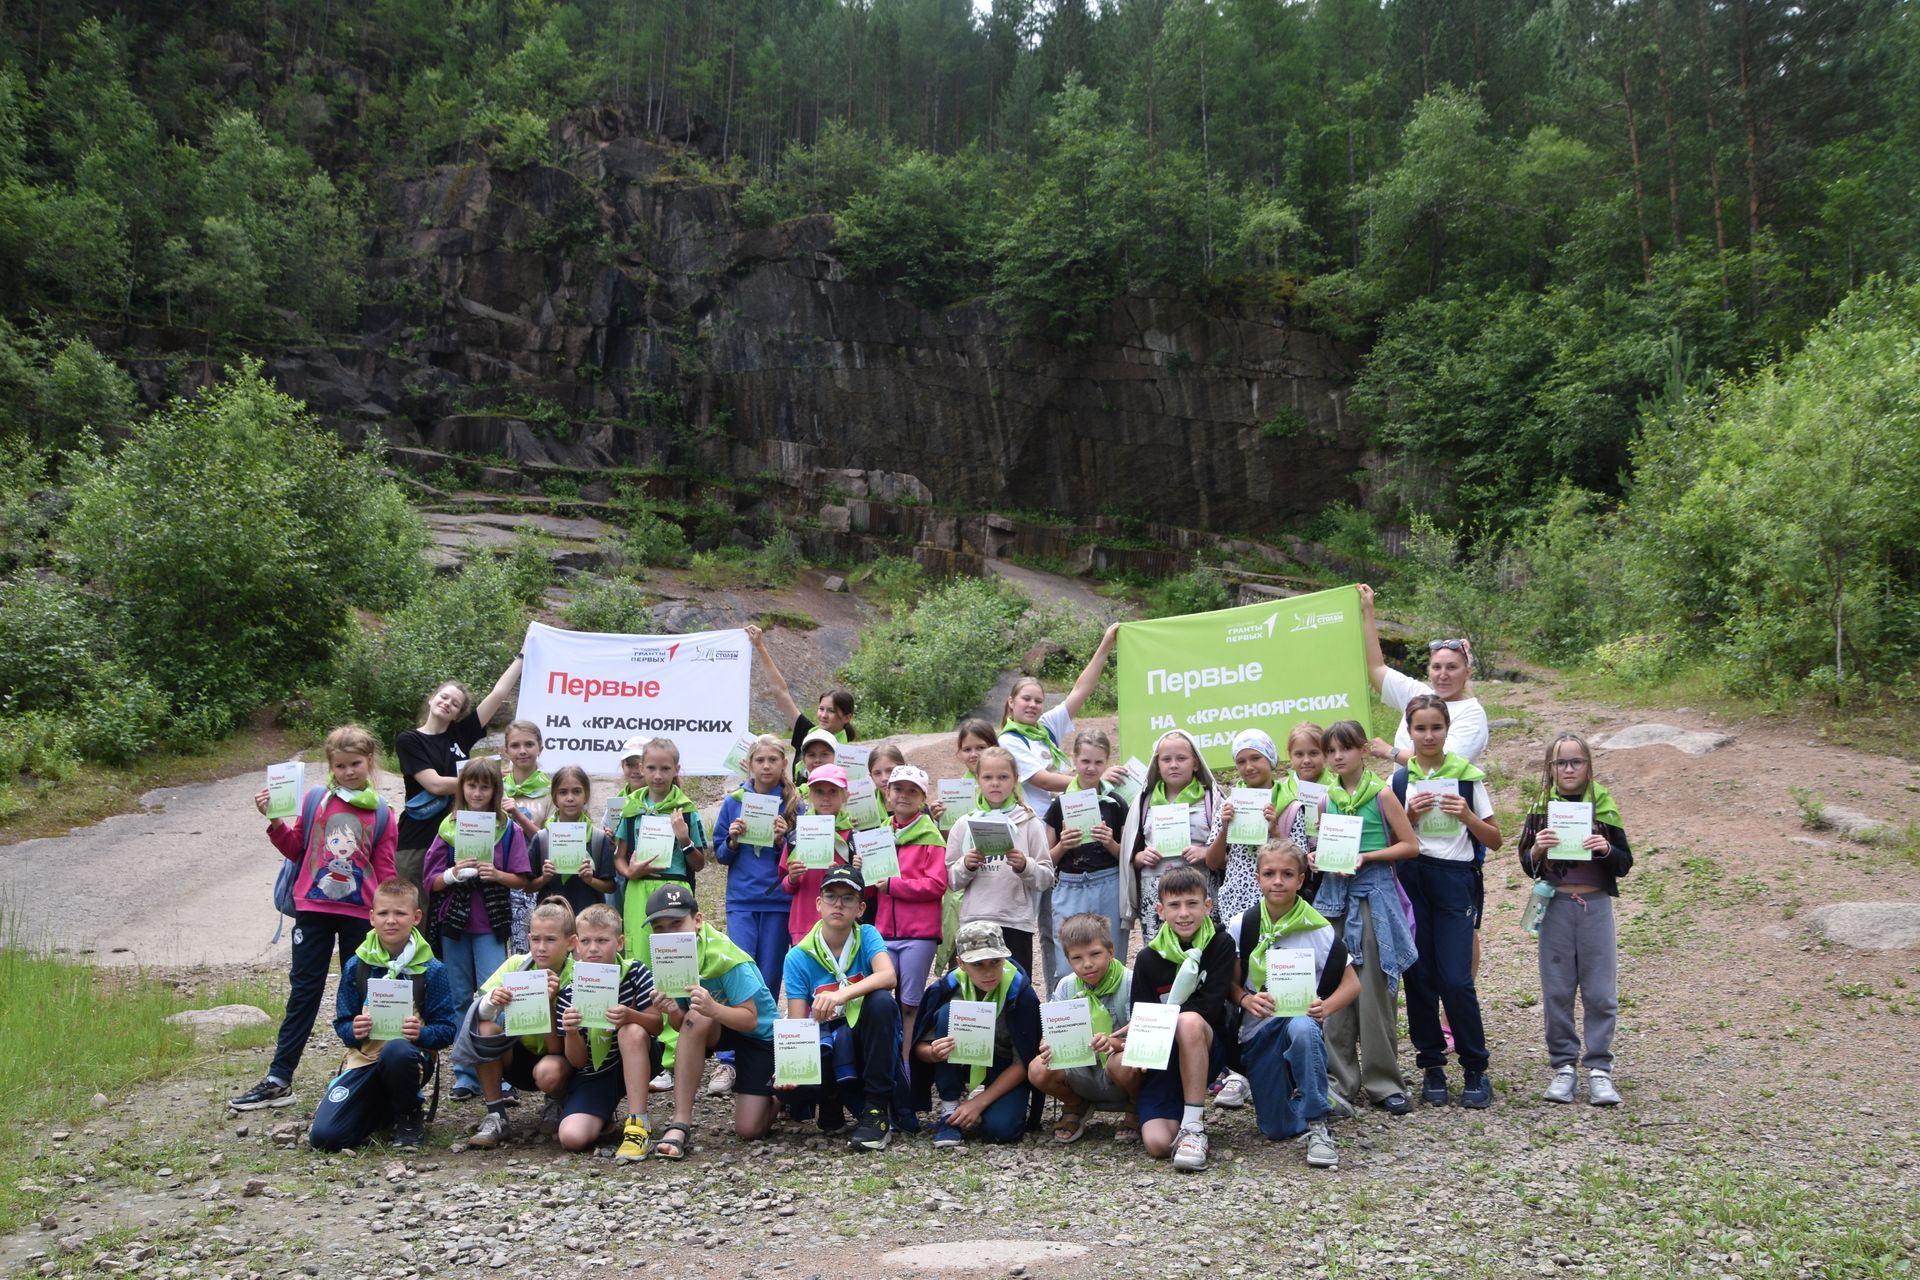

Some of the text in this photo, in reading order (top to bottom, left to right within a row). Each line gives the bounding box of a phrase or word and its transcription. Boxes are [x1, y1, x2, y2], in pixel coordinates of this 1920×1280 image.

[547, 671, 660, 702] Первые
[1147, 661, 1263, 697] Первые
[546, 715, 733, 733] НА «КРАСНОЯРСКИХ
[1151, 693, 1349, 729] НА «КРАСНОЯРСКИХ
